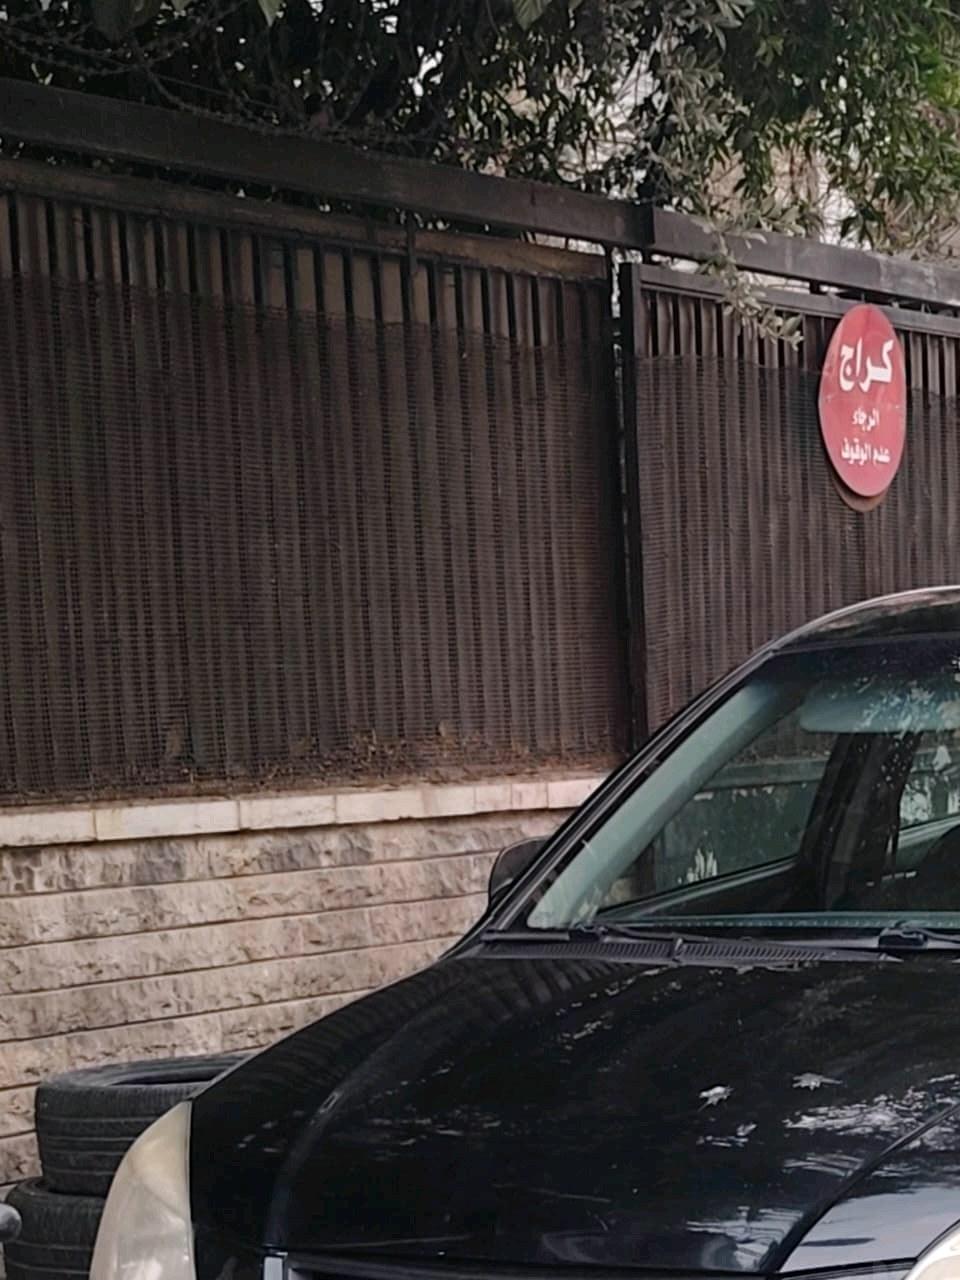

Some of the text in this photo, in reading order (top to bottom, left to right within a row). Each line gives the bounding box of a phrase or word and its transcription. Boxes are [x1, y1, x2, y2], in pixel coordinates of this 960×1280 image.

[839, 336, 894, 392] كراج
[852, 407, 880, 431] الرجاء
[841, 437, 891, 466] عدم الوقوف
